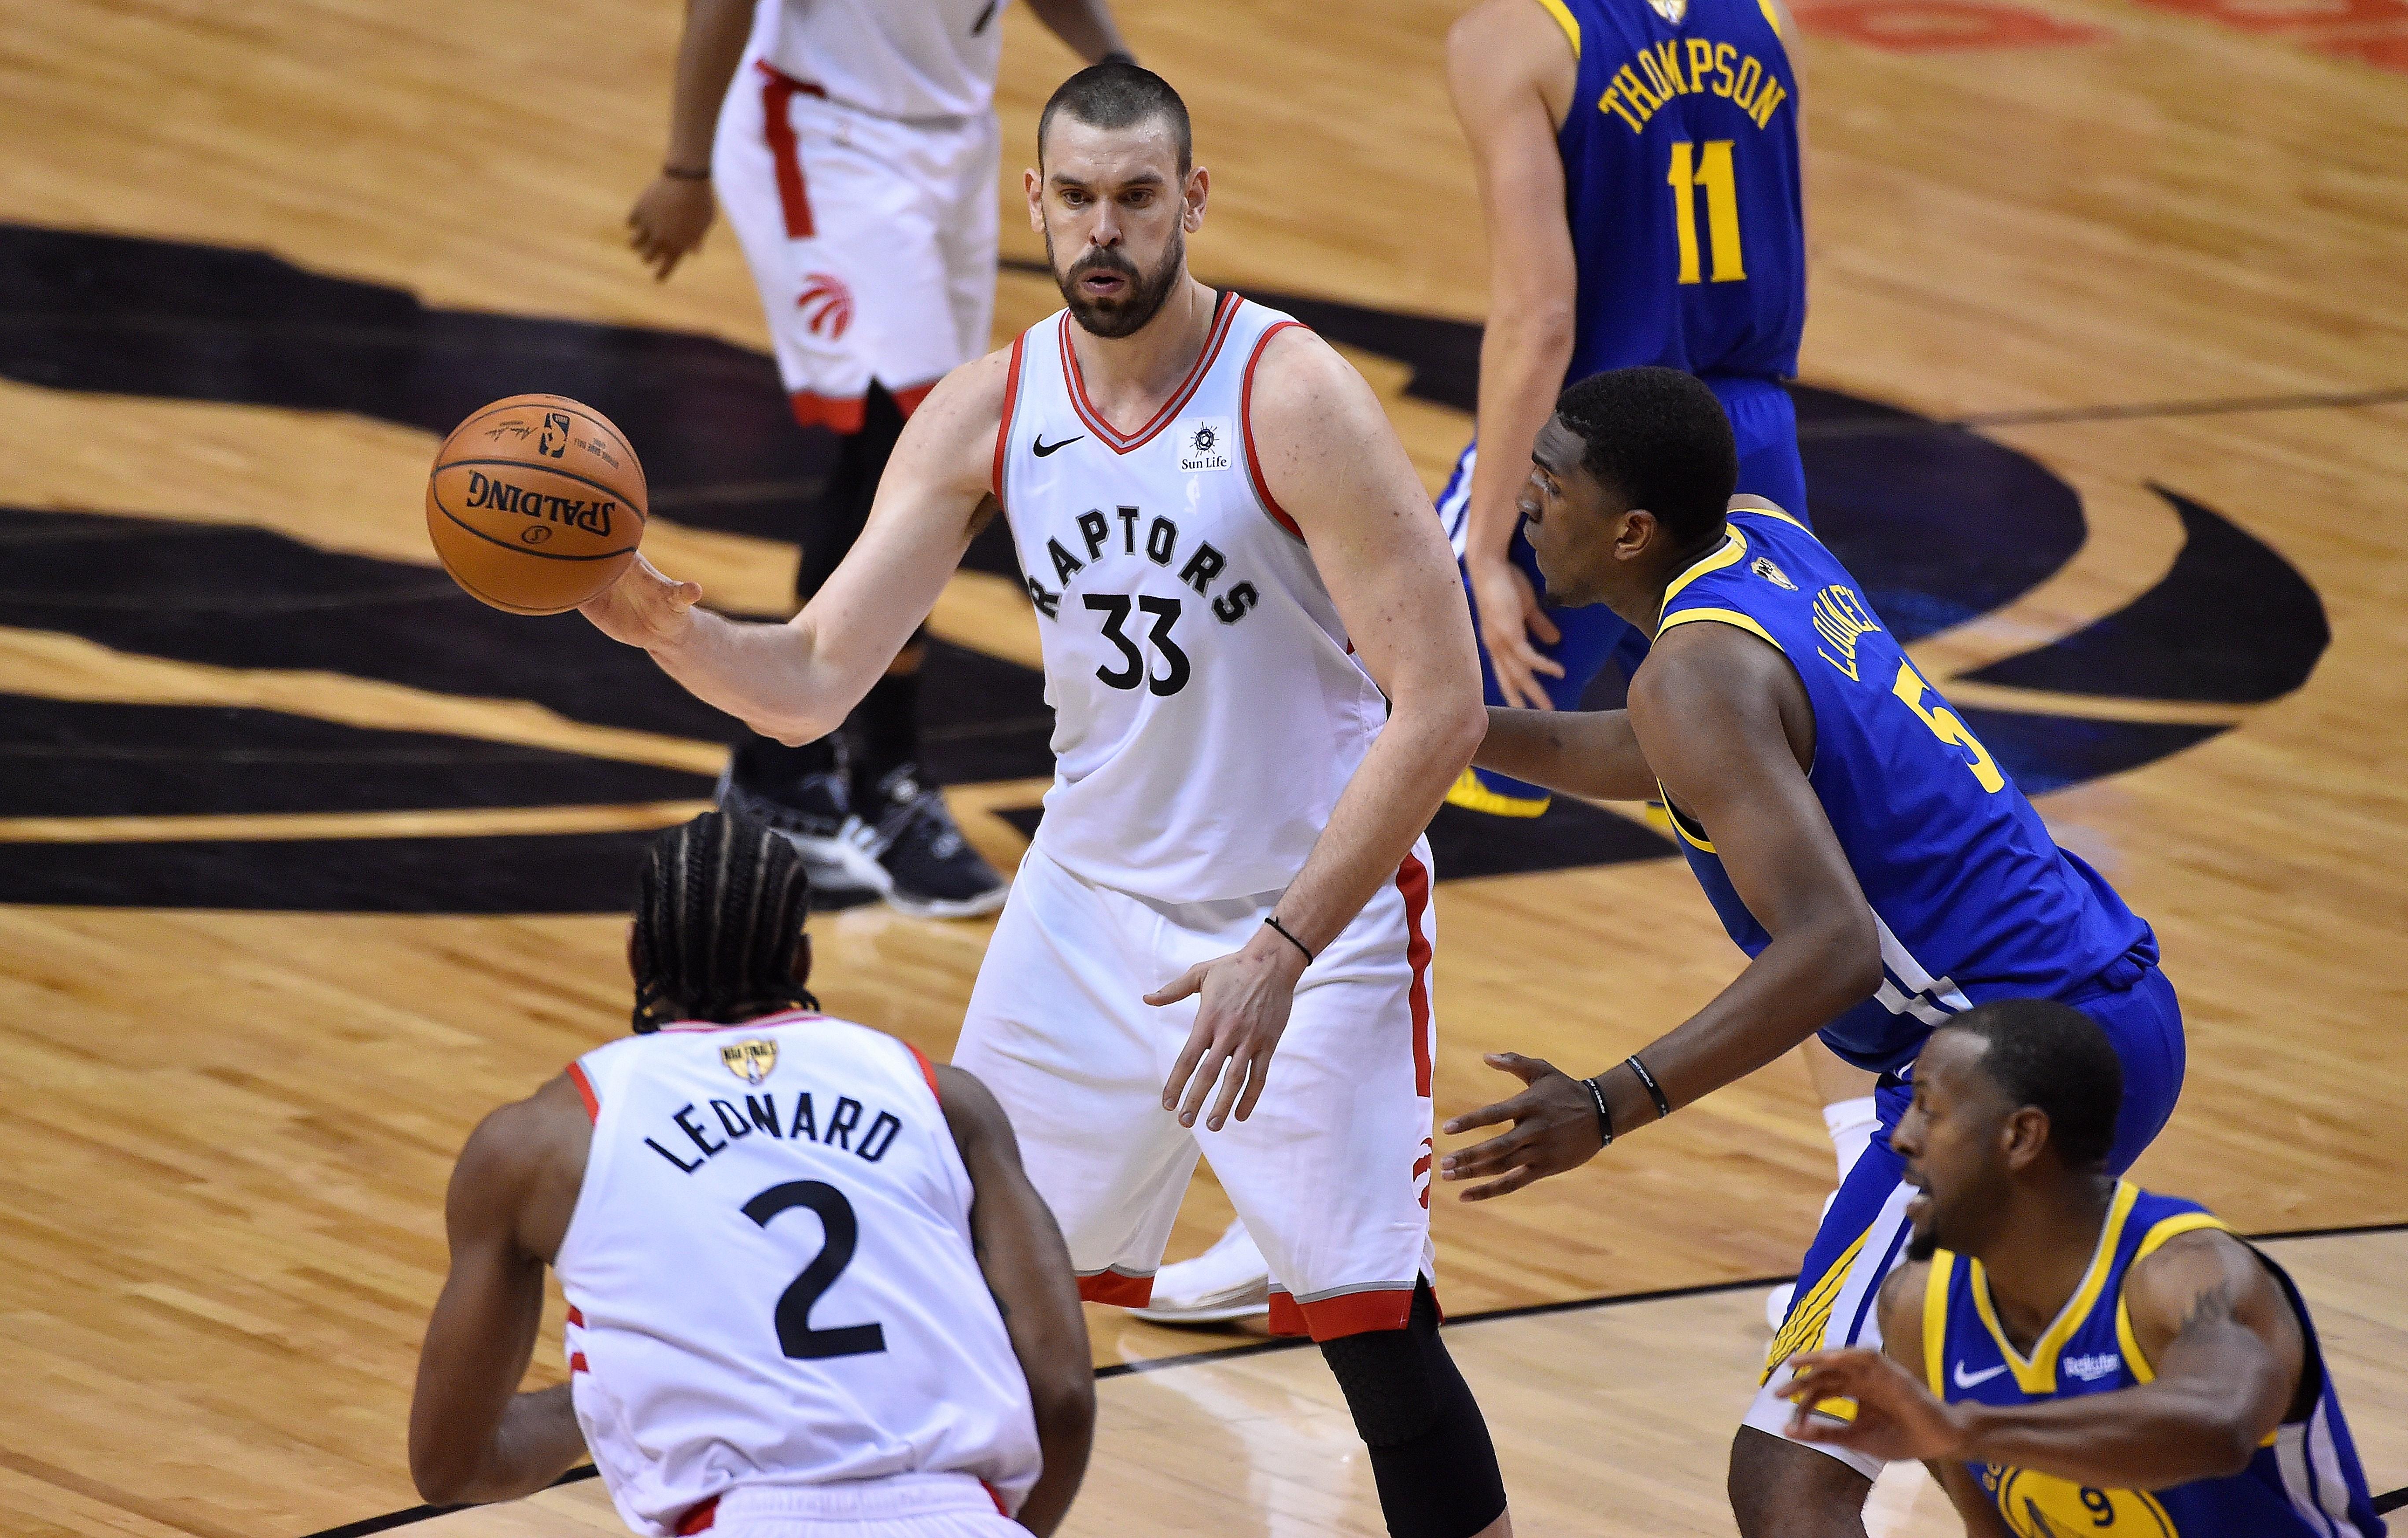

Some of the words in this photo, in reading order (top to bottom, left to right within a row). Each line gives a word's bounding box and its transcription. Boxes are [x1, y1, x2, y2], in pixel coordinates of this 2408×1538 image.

[1597, 38, 1787, 134] THOMPSON
[1667, 139, 1747, 284] 11
[466, 471, 615, 537] SPALDING
[1182, 459, 1203, 470] Sun
[1206, 456, 1227, 467] Life
[1028, 505, 1260, 625] RAPTORS
[1082, 593, 1191, 696] 33
[1813, 585, 1881, 682] LOONEY
[1892, 656, 2005, 793] 5
[644, 1092, 903, 1175] LEONARD
[740, 1179, 887, 1361] 2
[2080, 1486, 2114, 1527] 9
